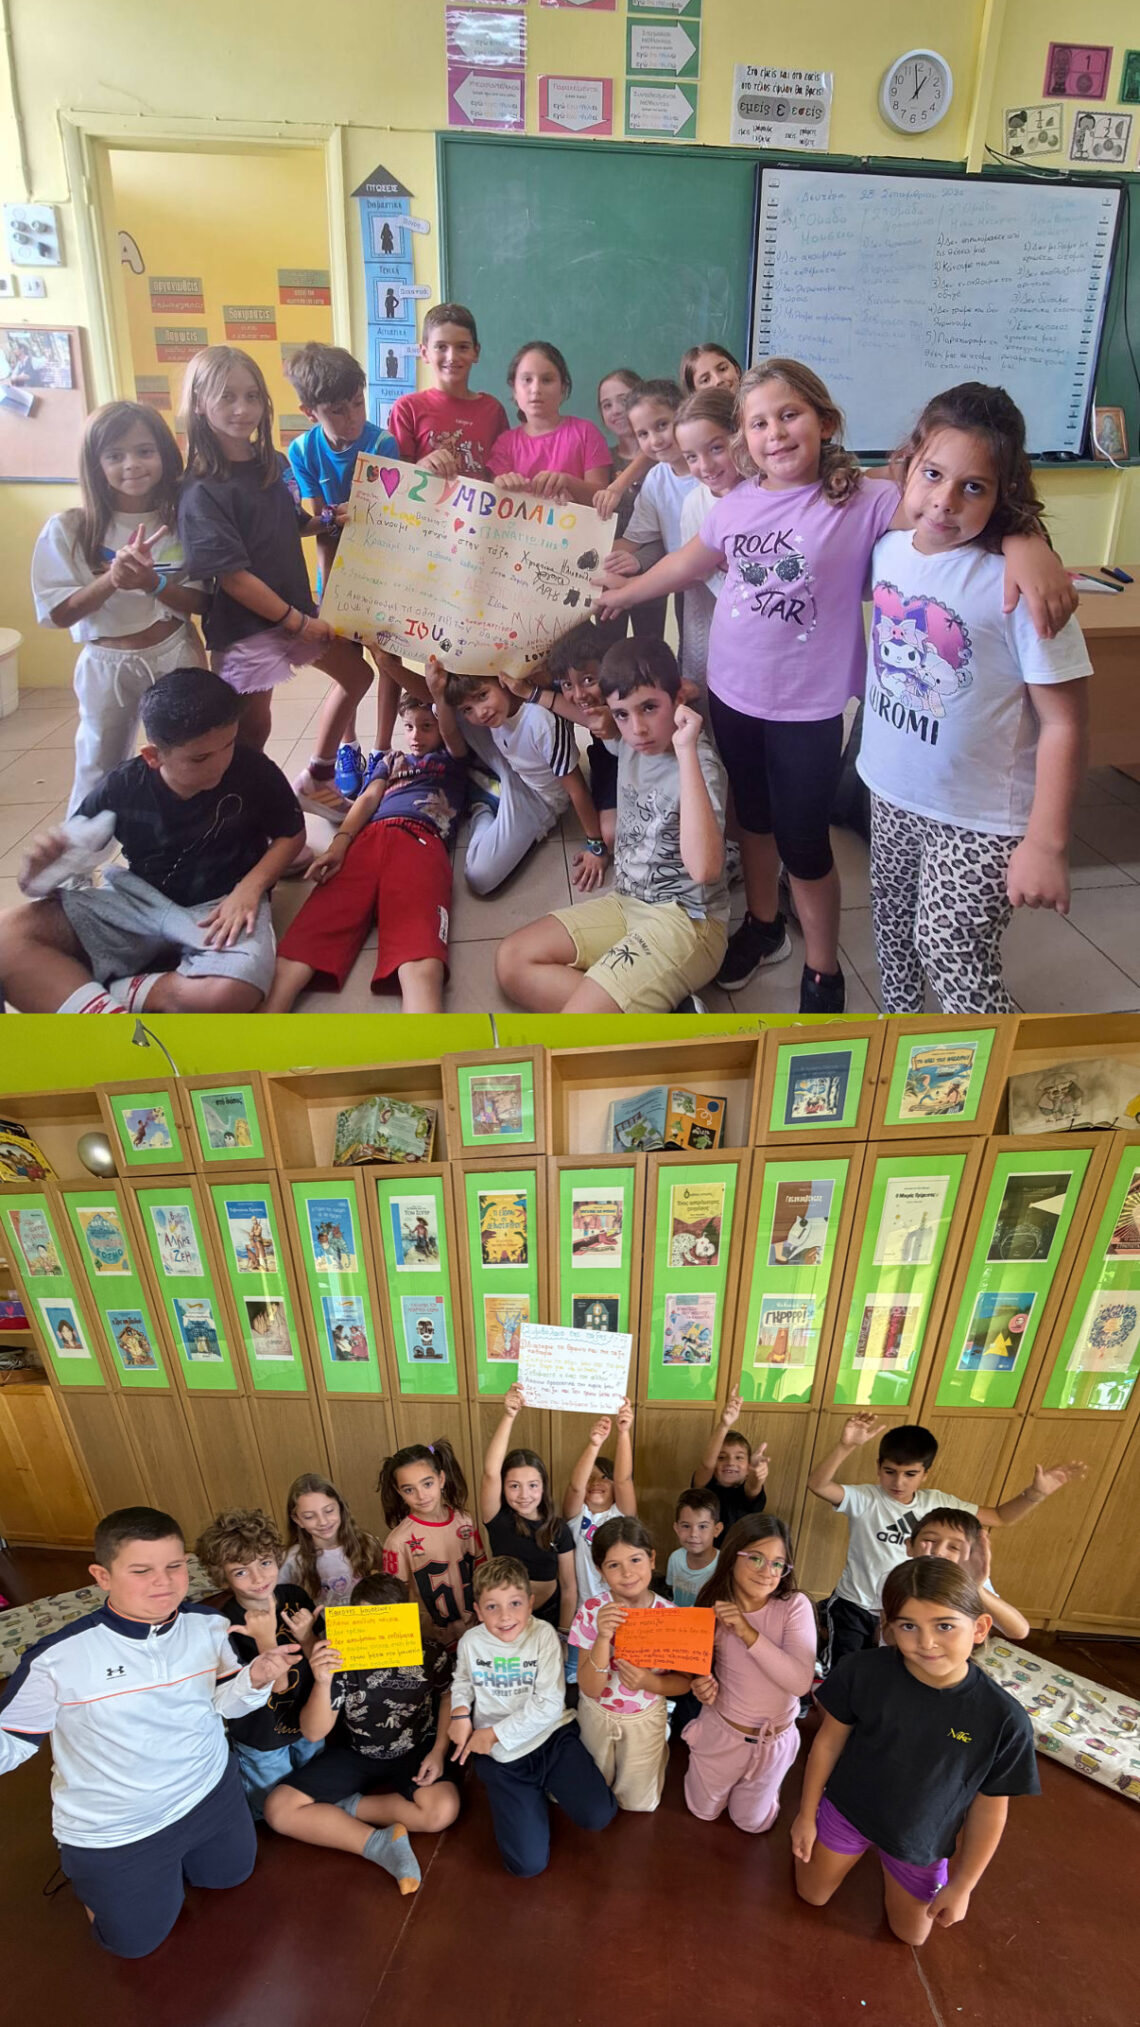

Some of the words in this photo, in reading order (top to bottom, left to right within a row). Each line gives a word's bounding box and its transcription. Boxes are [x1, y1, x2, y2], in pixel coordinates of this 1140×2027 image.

[904, 66, 912, 76] 11
[895, 75, 904, 85] 10
[933, 77, 940, 87] 2
[891, 87, 898, 97] 9
[934, 90, 941, 99] 3
[740, 101, 771, 116] εμείς
[892, 100, 899, 110] 8
[929, 102, 936, 112] 4
[900, 109, 907, 119] 7
[909, 114, 917, 124] 6
[921, 110, 927, 120] 5
[732, 528, 796, 558] ROCK
[750, 589, 807, 626] STAR
[868, 682, 940, 747] UROMI
[876, 1529, 905, 1546] adi
[494, 1656, 520, 1672] RE
[523, 1660, 538, 1668] OVE
[472, 1671, 534, 1688] CHARG
